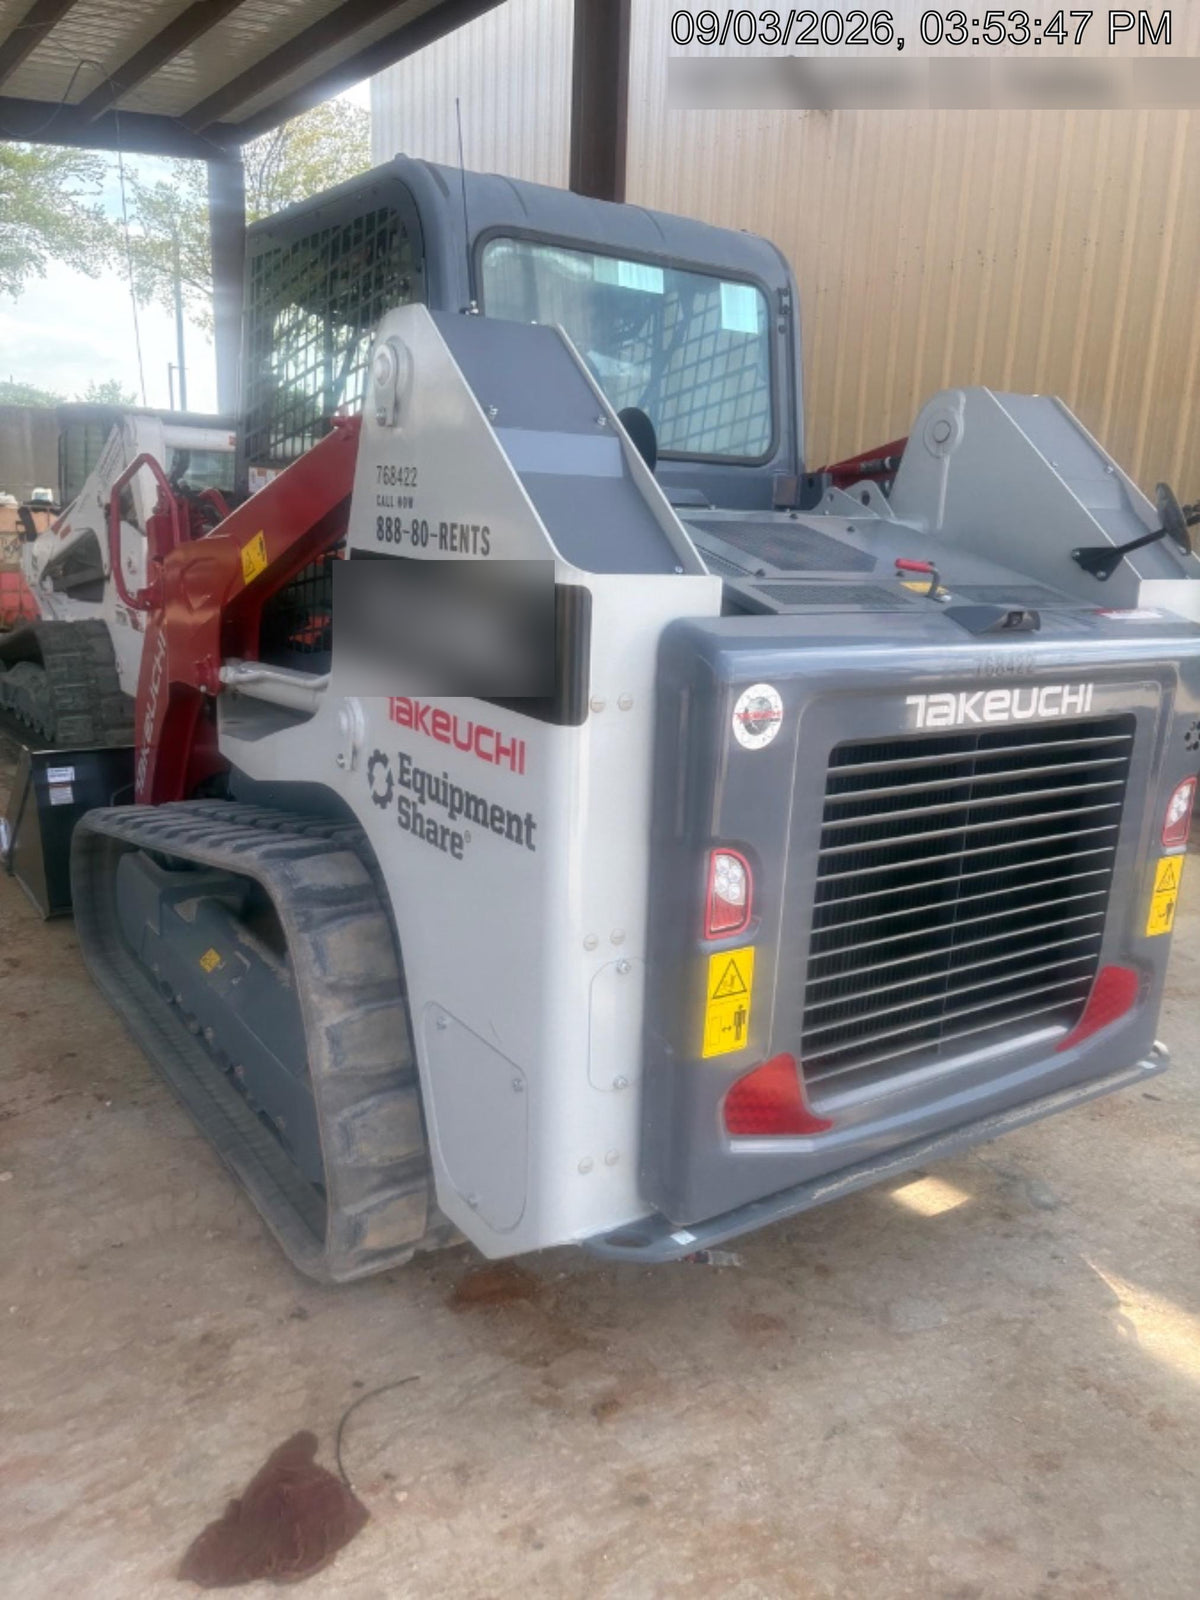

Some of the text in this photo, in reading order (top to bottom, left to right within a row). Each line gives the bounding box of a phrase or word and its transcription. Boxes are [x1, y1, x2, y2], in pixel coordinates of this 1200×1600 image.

[376, 465, 418, 487] 768422
[376, 494, 394, 508] CALL
[376, 515, 490, 557] 888-80-RENTS
[974, 654, 1036, 676] 768422
[397, 751, 537, 851] Equipment
